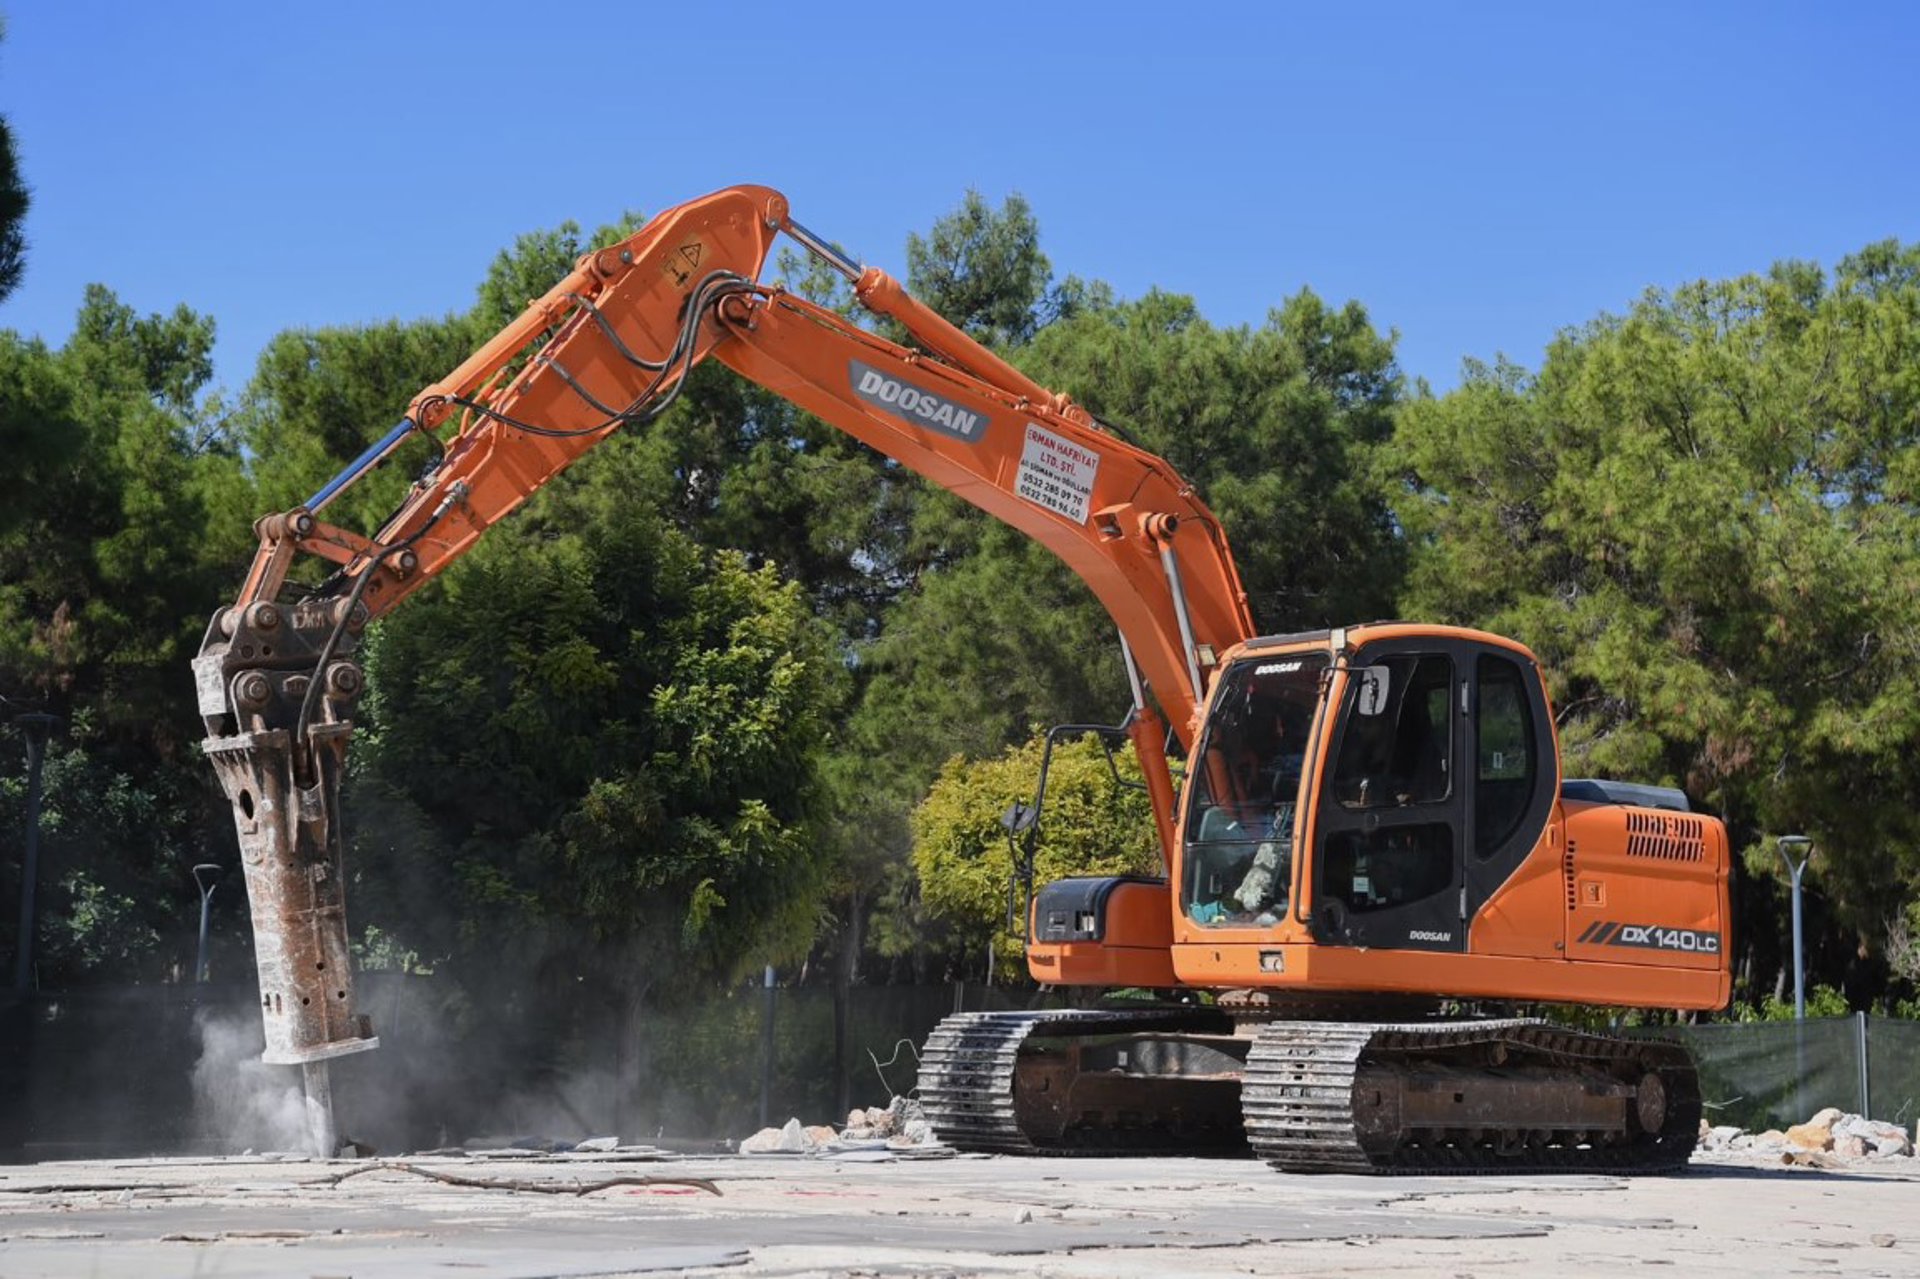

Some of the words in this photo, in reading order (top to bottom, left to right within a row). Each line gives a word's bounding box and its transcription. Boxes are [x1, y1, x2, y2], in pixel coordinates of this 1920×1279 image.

[858, 371, 977, 435] DOOSAN
[1027, 429, 1055, 450] ERMAN
[1057, 442, 1097, 469] HAFRİYAT
[1040, 451, 1058, 469] LTD.
[1020, 484, 1041, 500] 0532
[1023, 472, 1043, 488] 0532
[1073, 494, 1083, 506] 70
[1254, 662, 1302, 675] DOOSAN
[1409, 930, 1451, 942] DOOSAN
